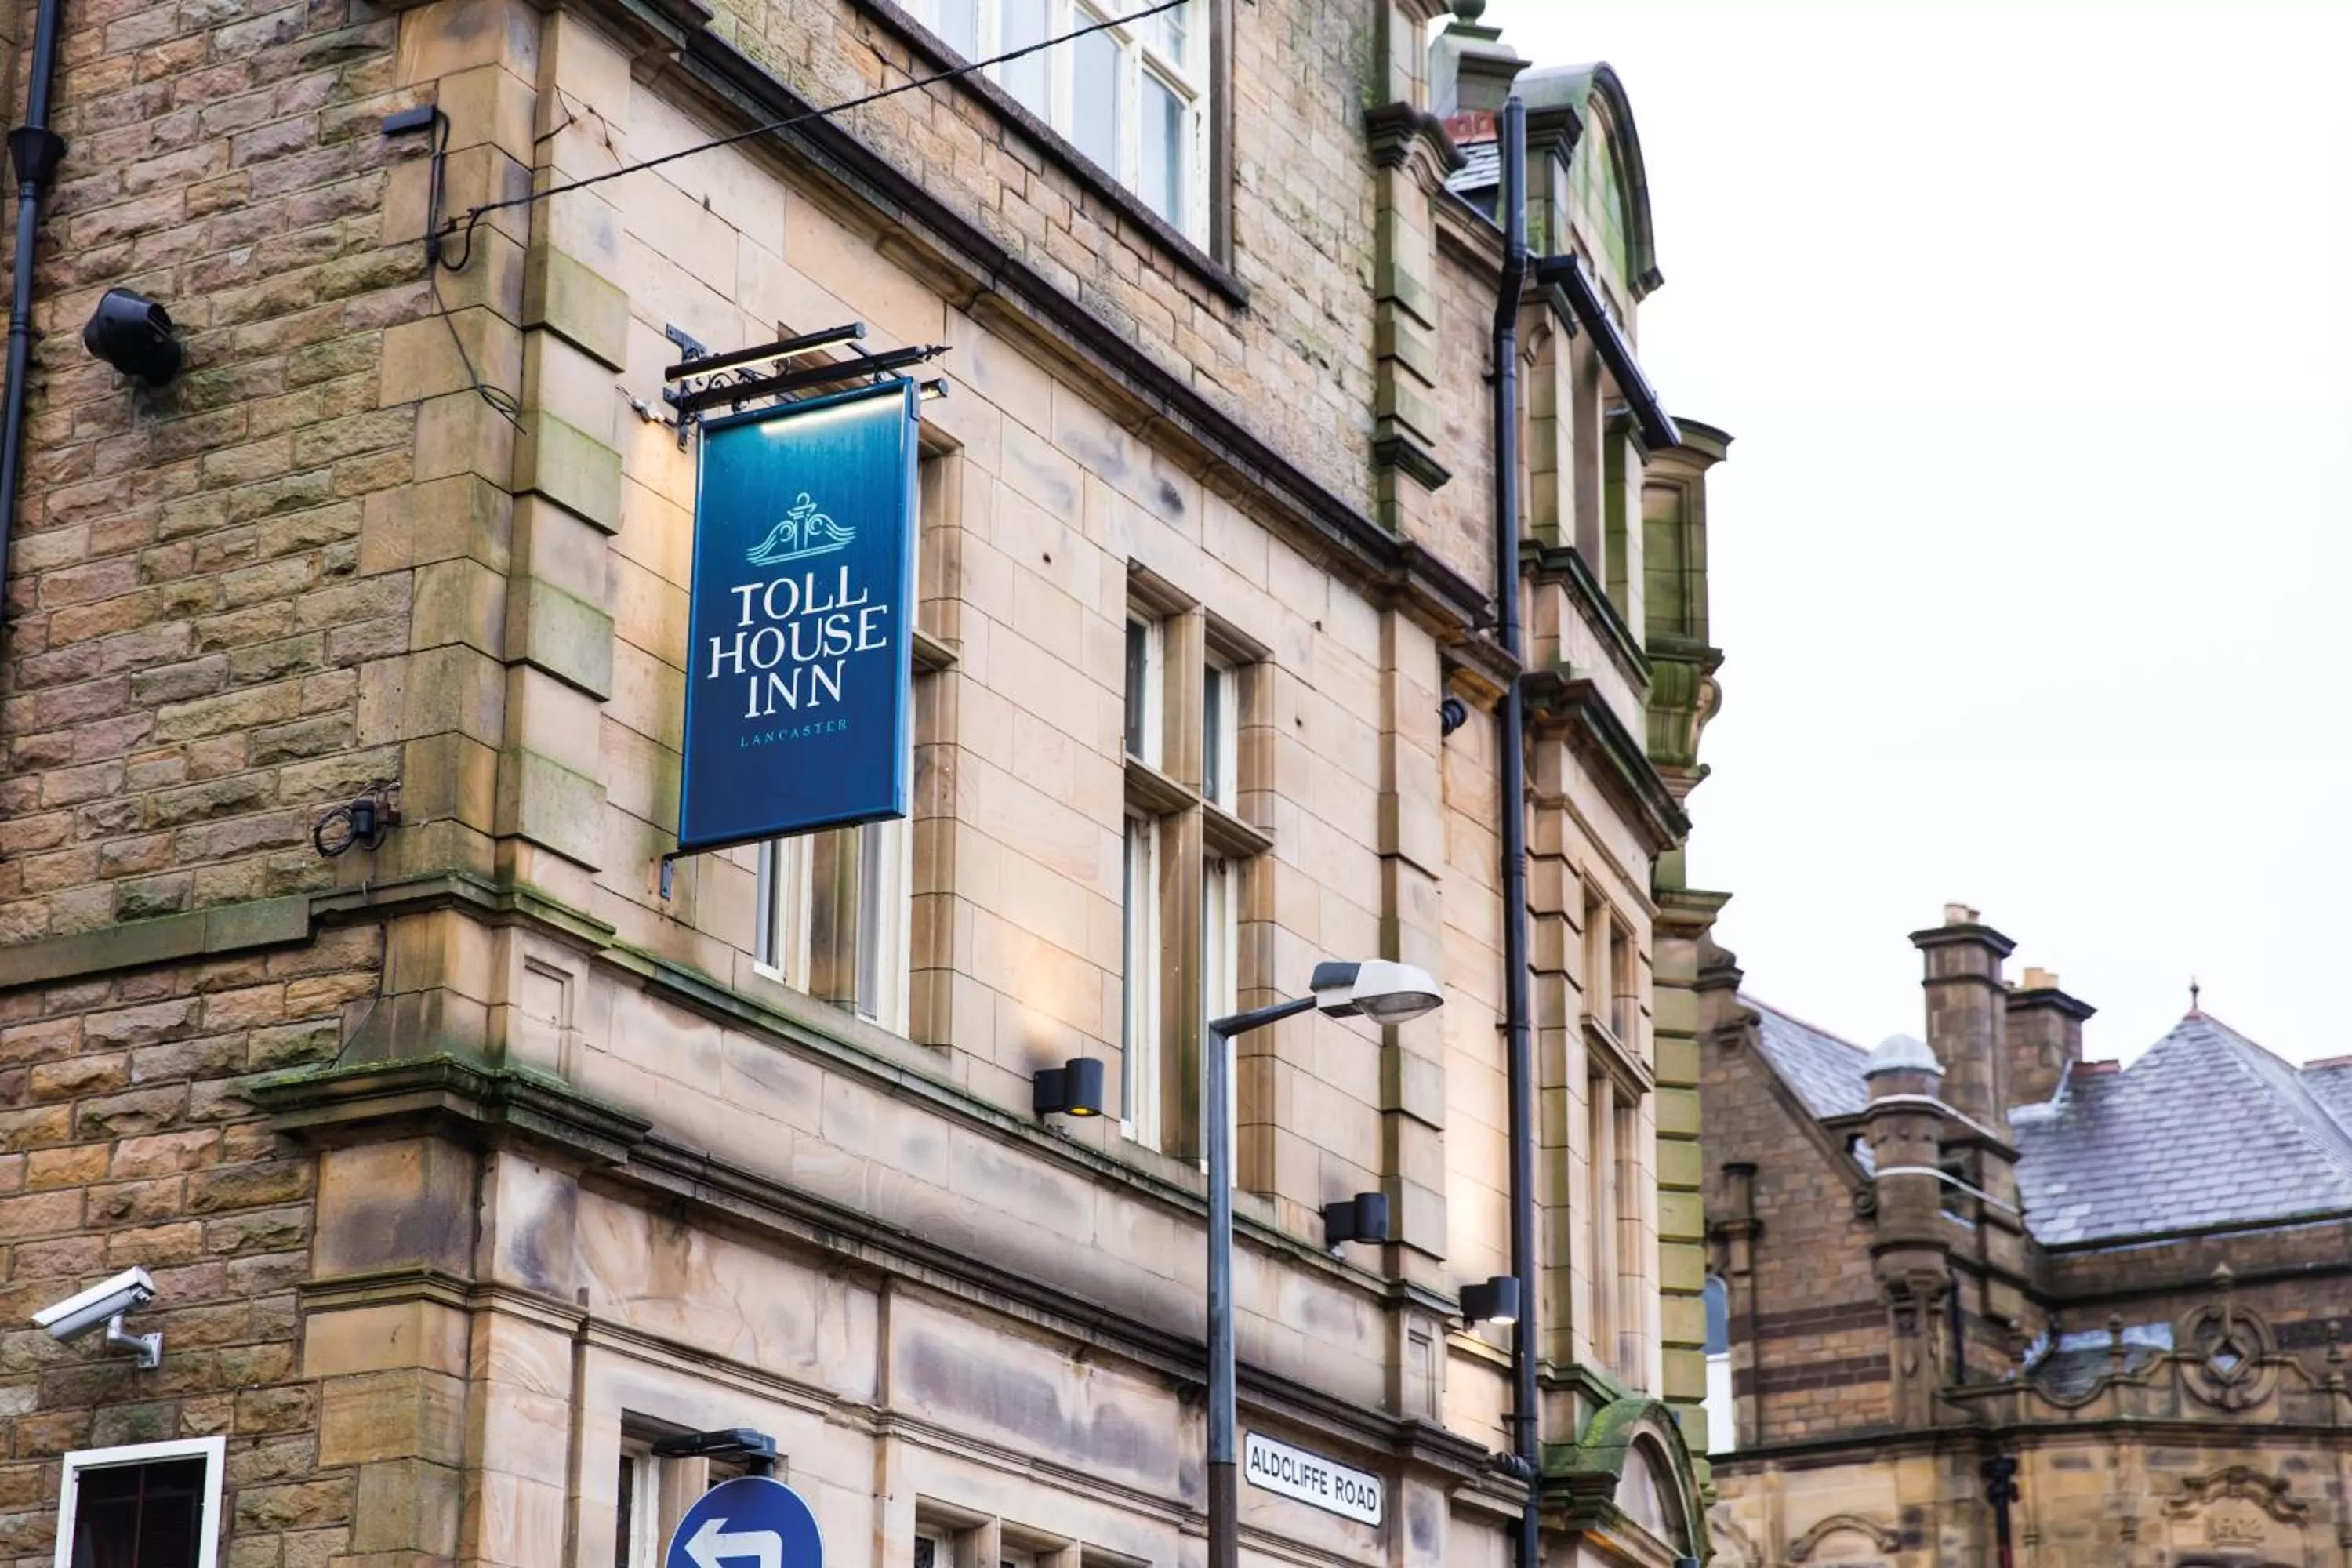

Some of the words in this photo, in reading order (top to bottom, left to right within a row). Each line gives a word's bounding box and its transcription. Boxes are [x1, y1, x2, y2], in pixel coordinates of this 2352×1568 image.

[731, 565, 868, 626] TOLL
[707, 604, 888, 680] HOUSE
[744, 660, 846, 718] INN
[741, 719, 848, 747] LANCASTER
[1250, 1446, 1328, 1495] ALDCLIFFE
[1335, 1476, 1377, 1511] ROAD
